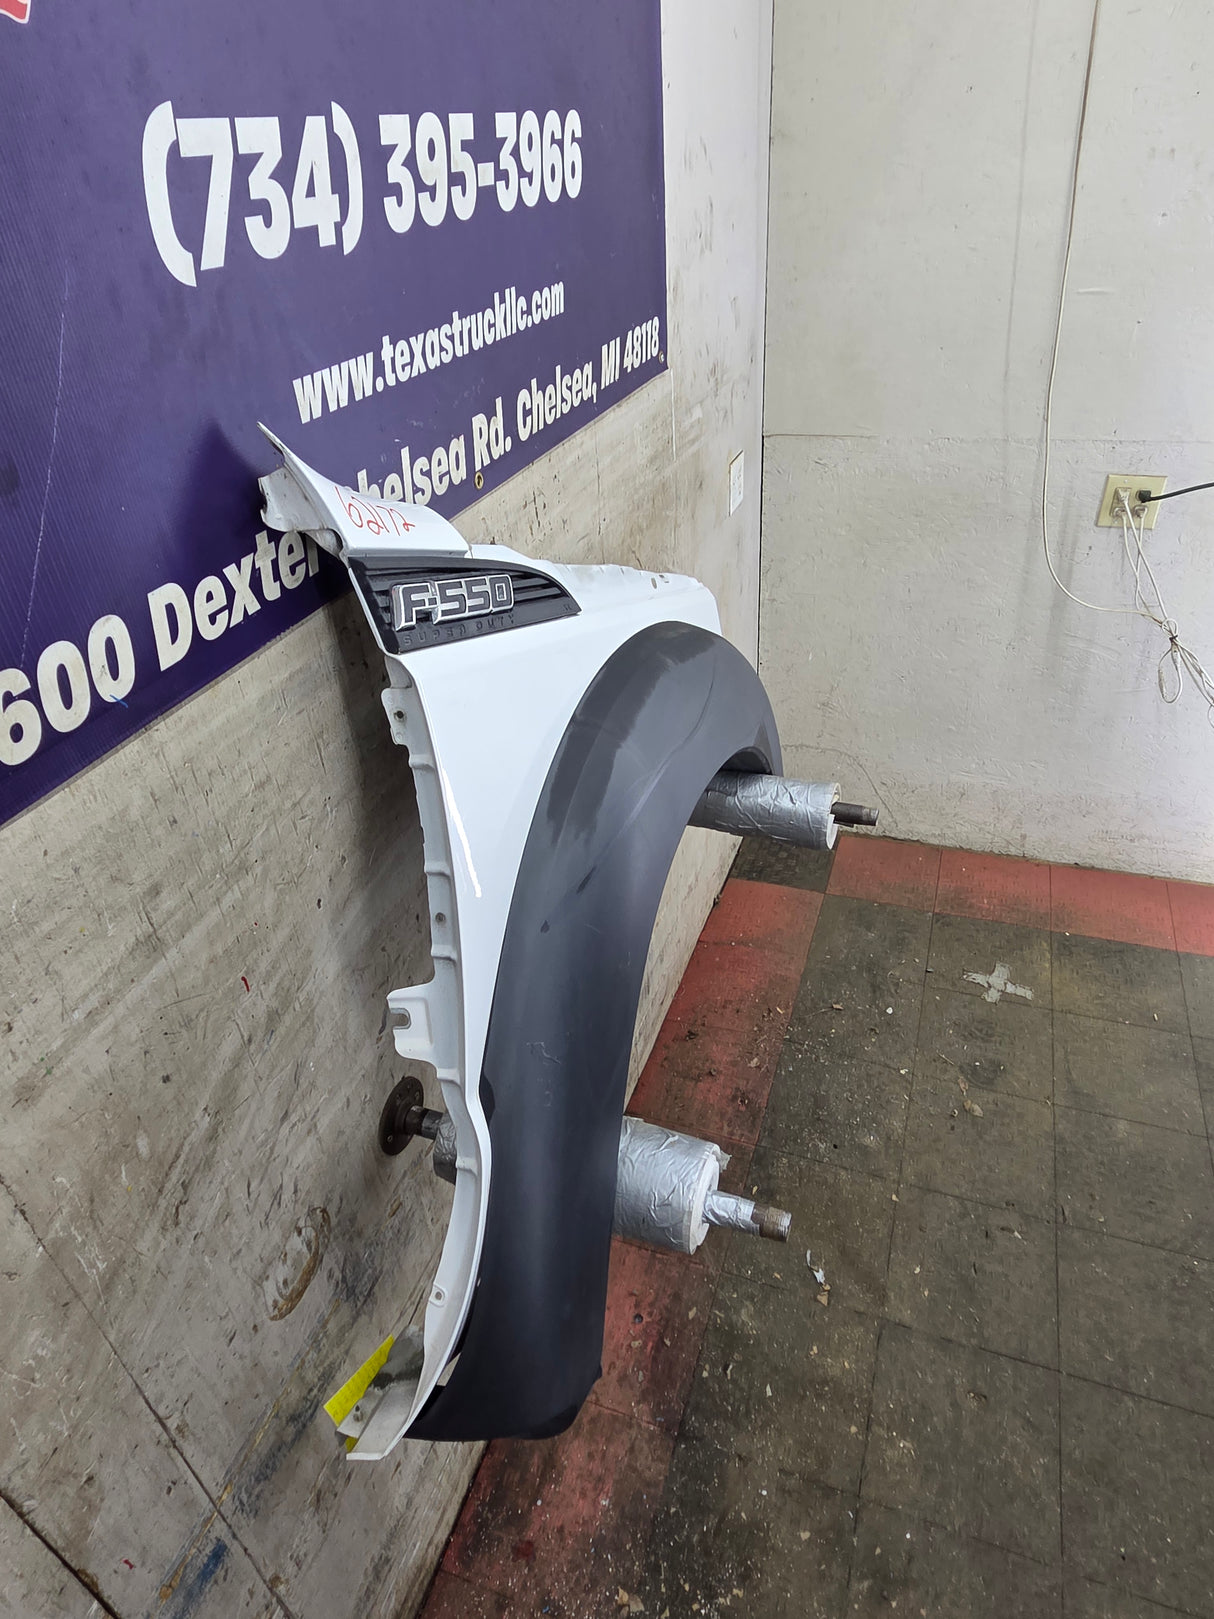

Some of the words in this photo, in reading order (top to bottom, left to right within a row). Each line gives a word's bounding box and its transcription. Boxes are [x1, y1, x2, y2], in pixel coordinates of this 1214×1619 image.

[142, 100, 363, 287] (734)
[379, 109, 583, 234] 395-3966
[292, 281, 565, 424] www.texastruckllc.com
[471, 397, 512, 473] Rd.
[516, 360, 597, 442] Chelsea,
[600, 337, 620, 390] MI
[623, 316, 660, 373] 48118
[392, 574, 514, 632] F-550
[403, 623, 467, 646] SUPER
[475, 613, 514, 631] DUTY
